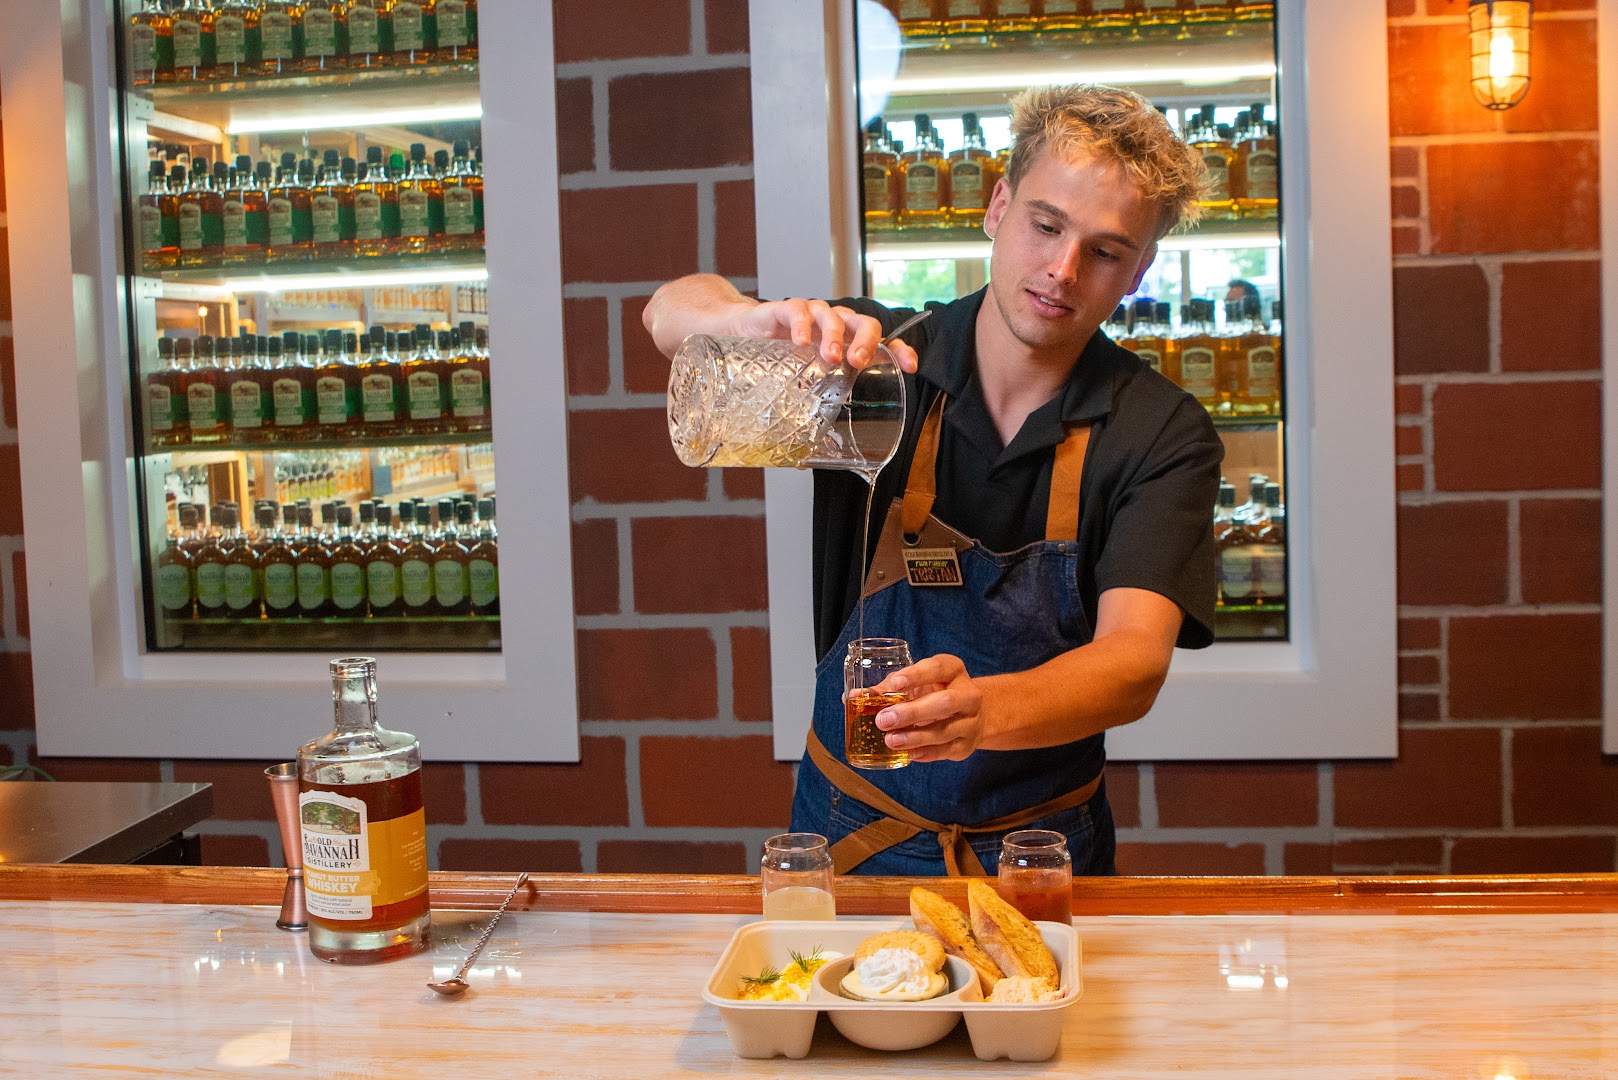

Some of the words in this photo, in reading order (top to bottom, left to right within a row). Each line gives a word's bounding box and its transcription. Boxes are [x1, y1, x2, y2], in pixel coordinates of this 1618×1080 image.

[910, 567, 957, 582] TRISTAN
[304, 833, 360, 859] SAVANNAH
[317, 837, 332, 845] OLD
[307, 857, 352, 868] DISTILLERY
[307, 876, 358, 893] WHISKEY
[328, 874, 360, 882] BUTTER
